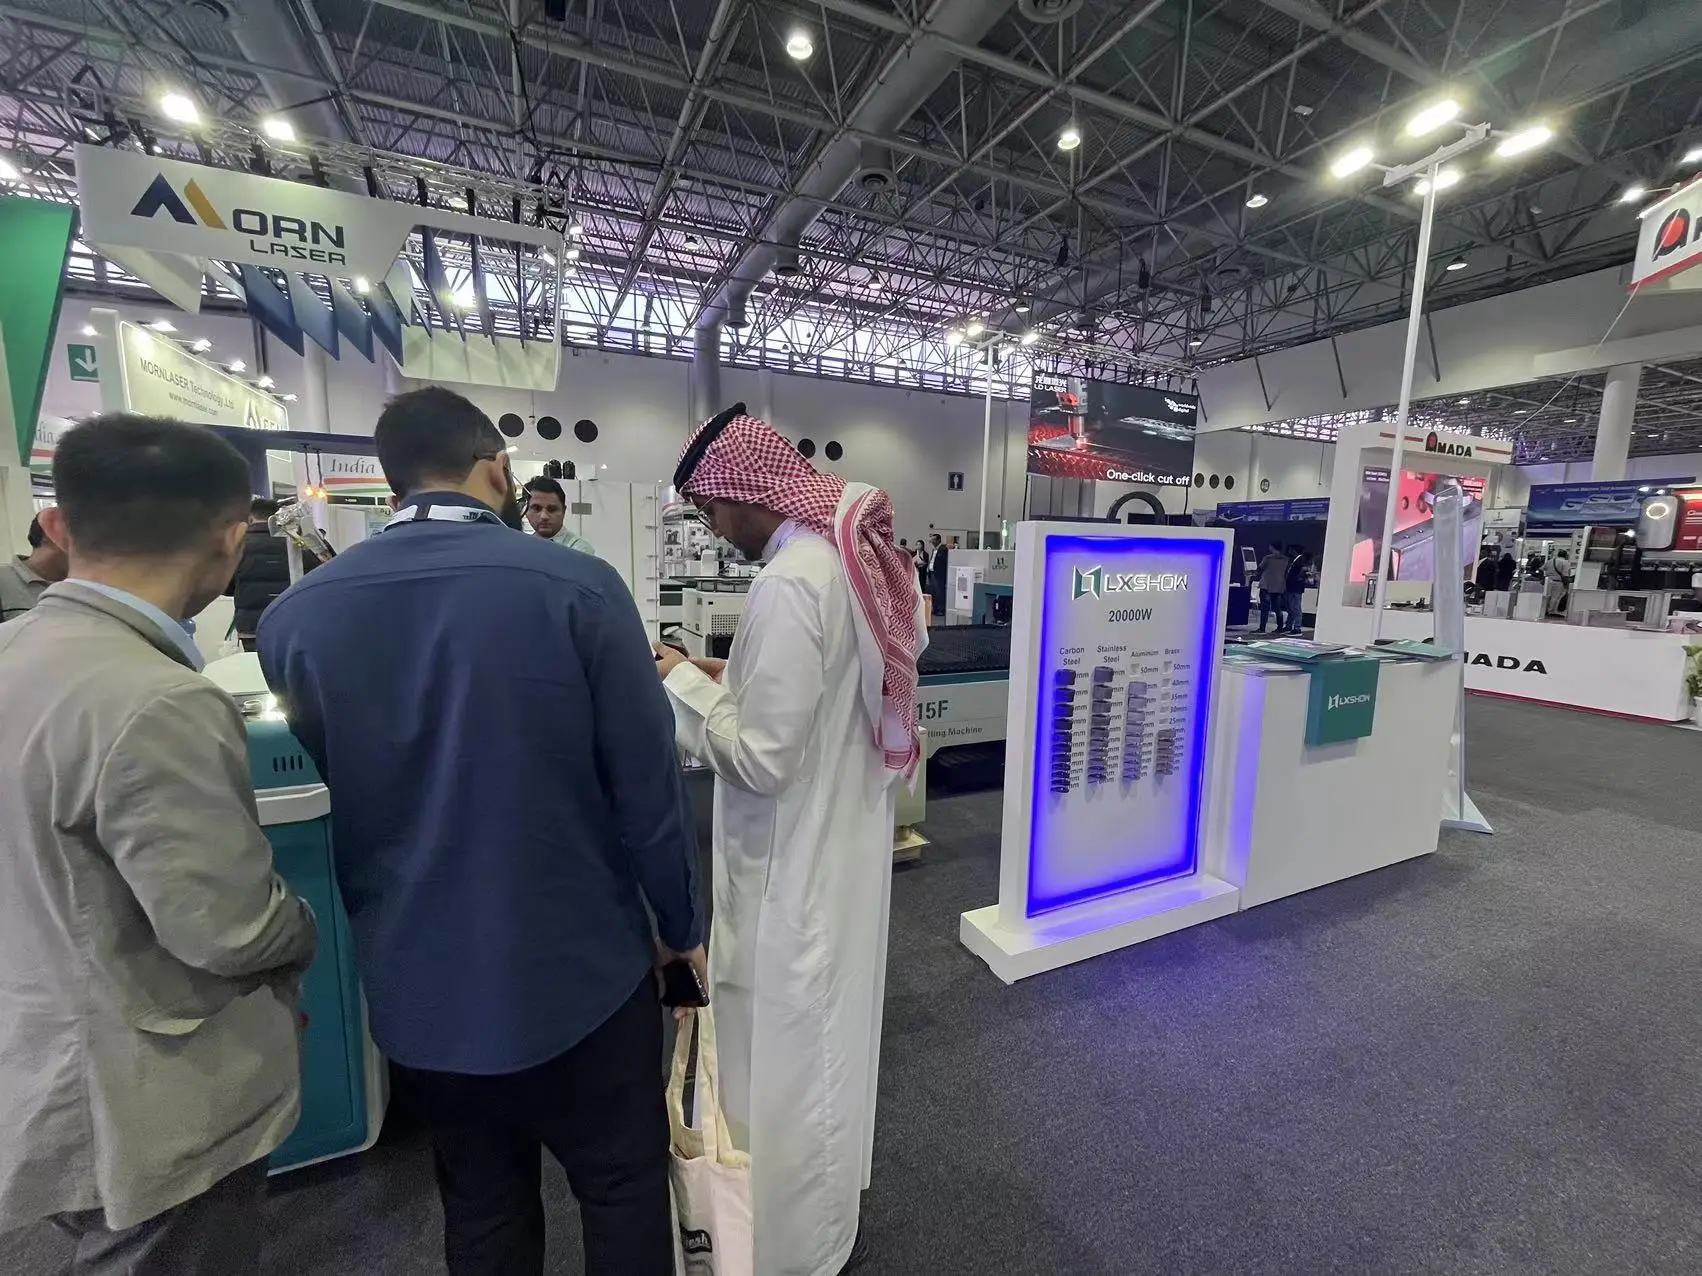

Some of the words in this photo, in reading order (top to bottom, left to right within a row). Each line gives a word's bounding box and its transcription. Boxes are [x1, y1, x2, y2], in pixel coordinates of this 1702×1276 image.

[249, 239, 346, 265] LASER
[140, 357, 189, 390] MORNLASER
[1425, 431, 1472, 458] AMADA
[330, 457, 375, 474] India
[1106, 468, 1155, 483] One-click
[1157, 474, 1173, 484] cut
[1175, 475, 1190, 485] off
[1104, 573, 1188, 593] LXSHOW
[1108, 607, 1152, 622] 20000W
[1059, 646, 1085, 655] Carbon
[1096, 644, 1127, 653] Stainless
[1063, 657, 1081, 666] Steel
[1103, 655, 1120, 663] Steel
[1173, 663, 1190, 671] 50mm
[1464, 651, 1547, 674] ADA
[916, 699, 949, 720] 15F
[1169, 717, 1186, 725] 25mm
[928, 727, 946, 738] tting
[948, 726, 983, 736] Machine
